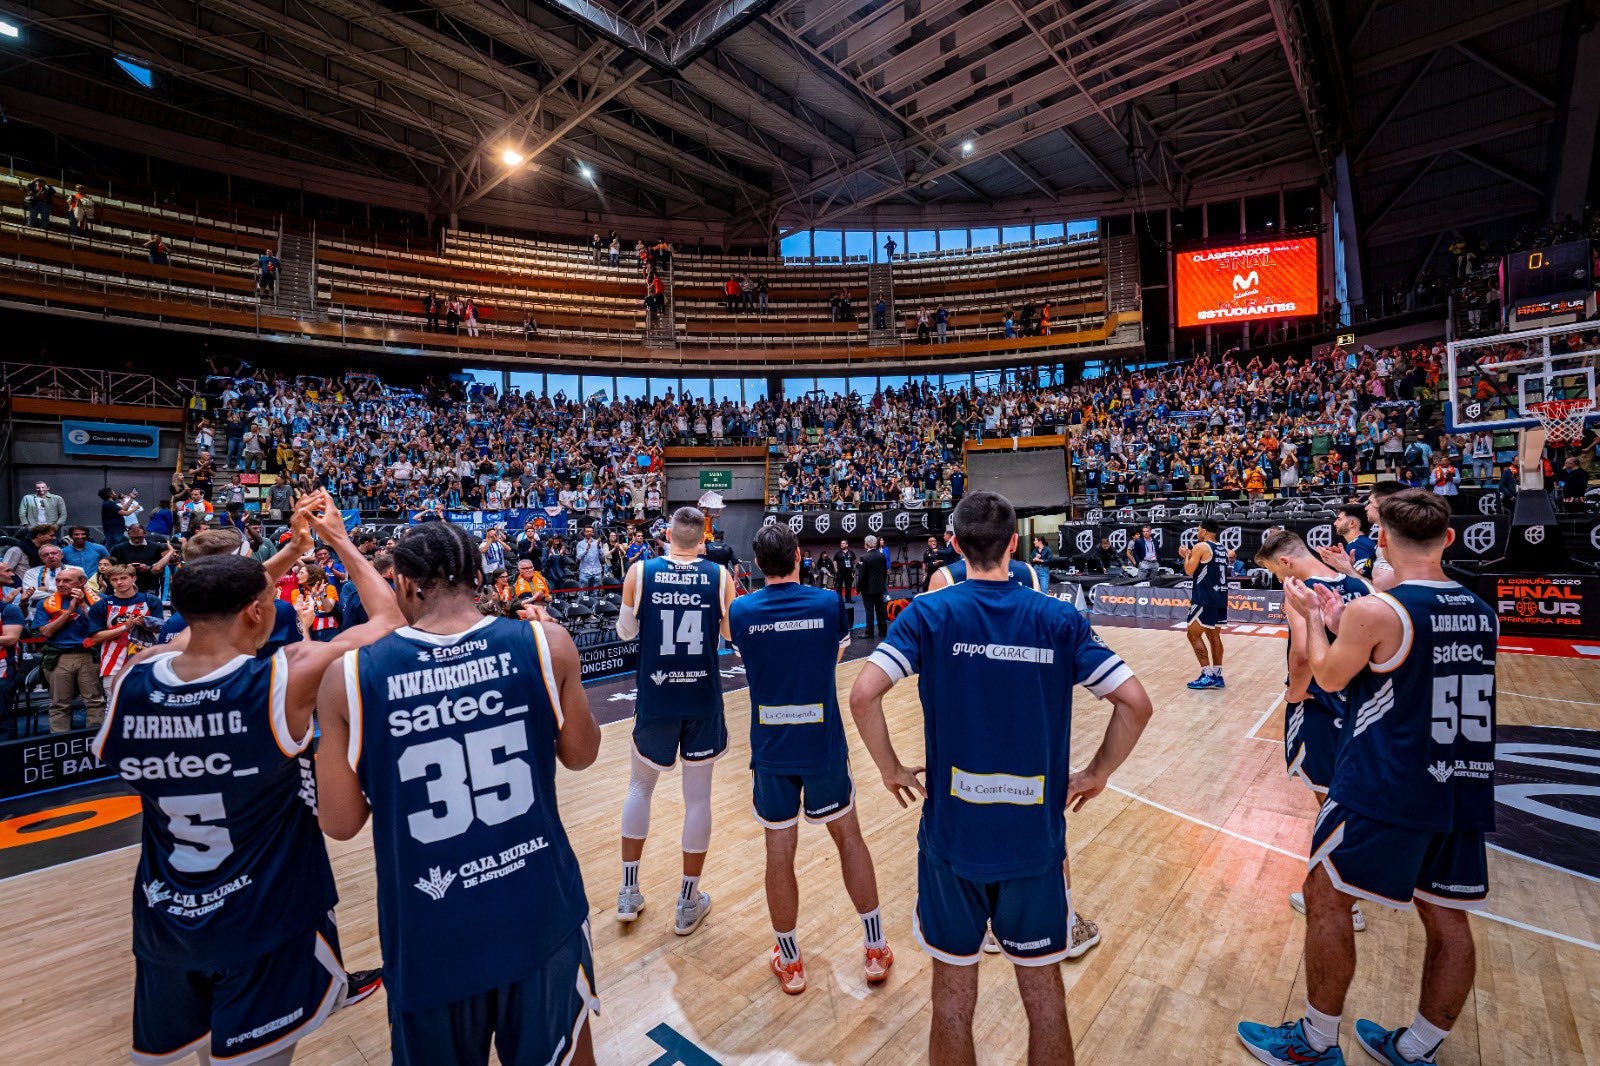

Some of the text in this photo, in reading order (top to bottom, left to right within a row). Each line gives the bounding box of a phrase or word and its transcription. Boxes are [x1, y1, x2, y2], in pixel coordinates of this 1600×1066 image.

[1193, 247, 1270, 262] CLASIFICADOS
[1197, 302, 1296, 320] ESTUDIANTES
[1517, 305, 1549, 316] FINAL
[654, 571, 711, 585] SHELIST D.
[1508, 577, 1552, 585] CORUÑA
[1100, 595, 1192, 608] TODO O NADA
[1497, 585, 1583, 600] FINAL
[1228, 600, 1264, 611] NAL
[748, 620, 804, 635] grupo CARAC
[1430, 614, 1493, 632] LOBACO R.
[659, 609, 704, 656] 14
[432, 639, 488, 659] Enerthy
[608, 642, 640, 658] ESPAÑO
[952, 642, 1029, 660] grupo CARAC
[580, 658, 624, 675] ONCESTO
[386, 652, 518, 701] NWAOKORIE F.
[1431, 674, 1495, 744] 55
[122, 714, 205, 739] PARHAM
[228, 710, 248, 734] G.
[23, 736, 97, 764] FEDER
[24, 763, 55, 784] DE
[398, 720, 535, 845] 35
[960, 780, 971, 792] La
[158, 792, 235, 873] 5
[459, 836, 549, 877] CAJA RURAL
[462, 858, 526, 889] DE ASTURIAS
[201, 874, 253, 905] RURAL
[226, 1031, 252, 1047] grupo
